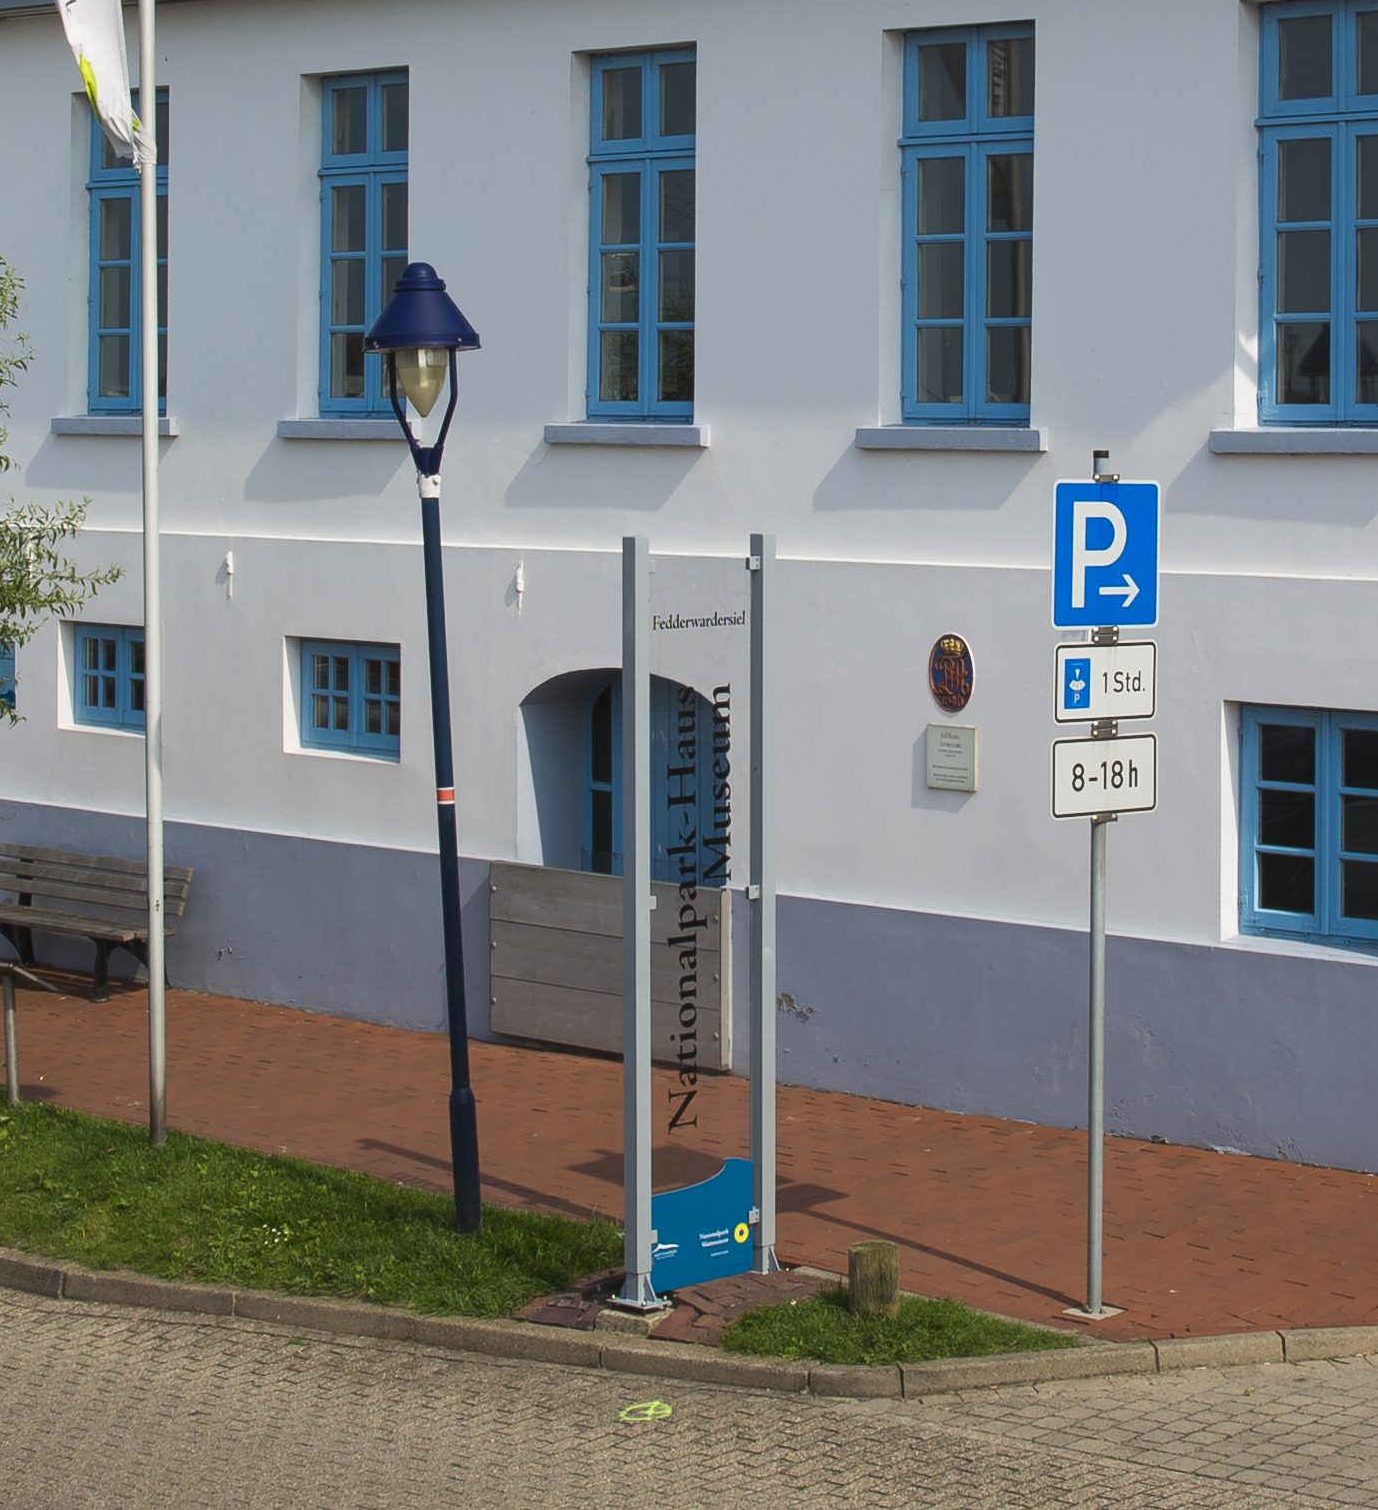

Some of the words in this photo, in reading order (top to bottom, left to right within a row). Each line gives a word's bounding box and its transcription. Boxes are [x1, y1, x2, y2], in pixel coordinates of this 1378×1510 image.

[1072, 501, 1127, 608] P
[652, 609, 746, 631] Fedderwardersiel
[1102, 671, 1108, 694] 1
[1112, 670, 1146, 693] Std.
[702, 682, 732, 883] Museum
[666, 685, 709, 1135] Nationalpark-Haus
